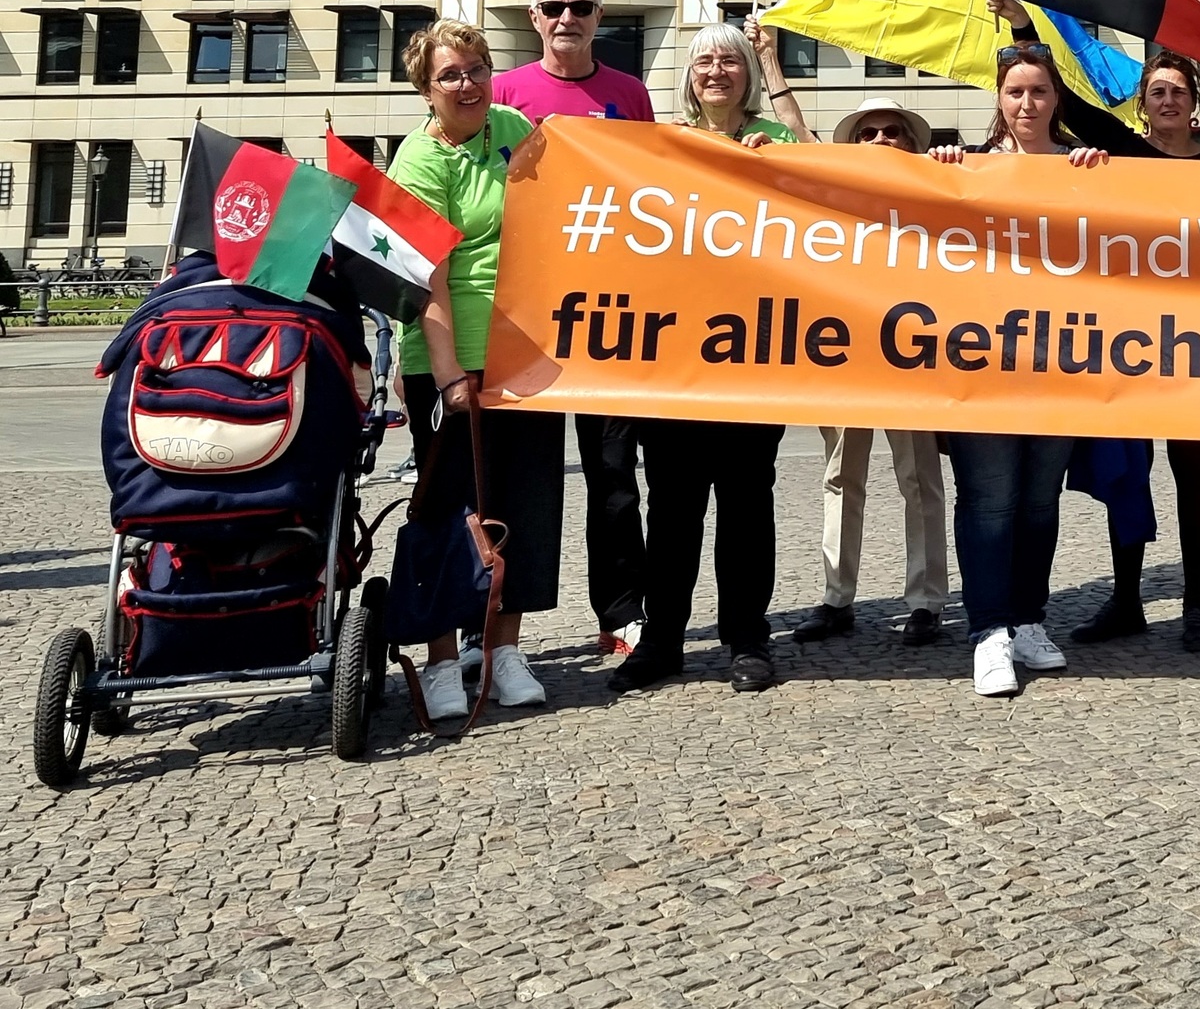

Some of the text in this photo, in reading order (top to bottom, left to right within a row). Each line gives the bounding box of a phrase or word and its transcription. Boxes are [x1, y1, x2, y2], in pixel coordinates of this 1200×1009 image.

[551, 291, 677, 362] für
[700, 296, 851, 367] alle
[149, 437, 235, 465] TAKO
